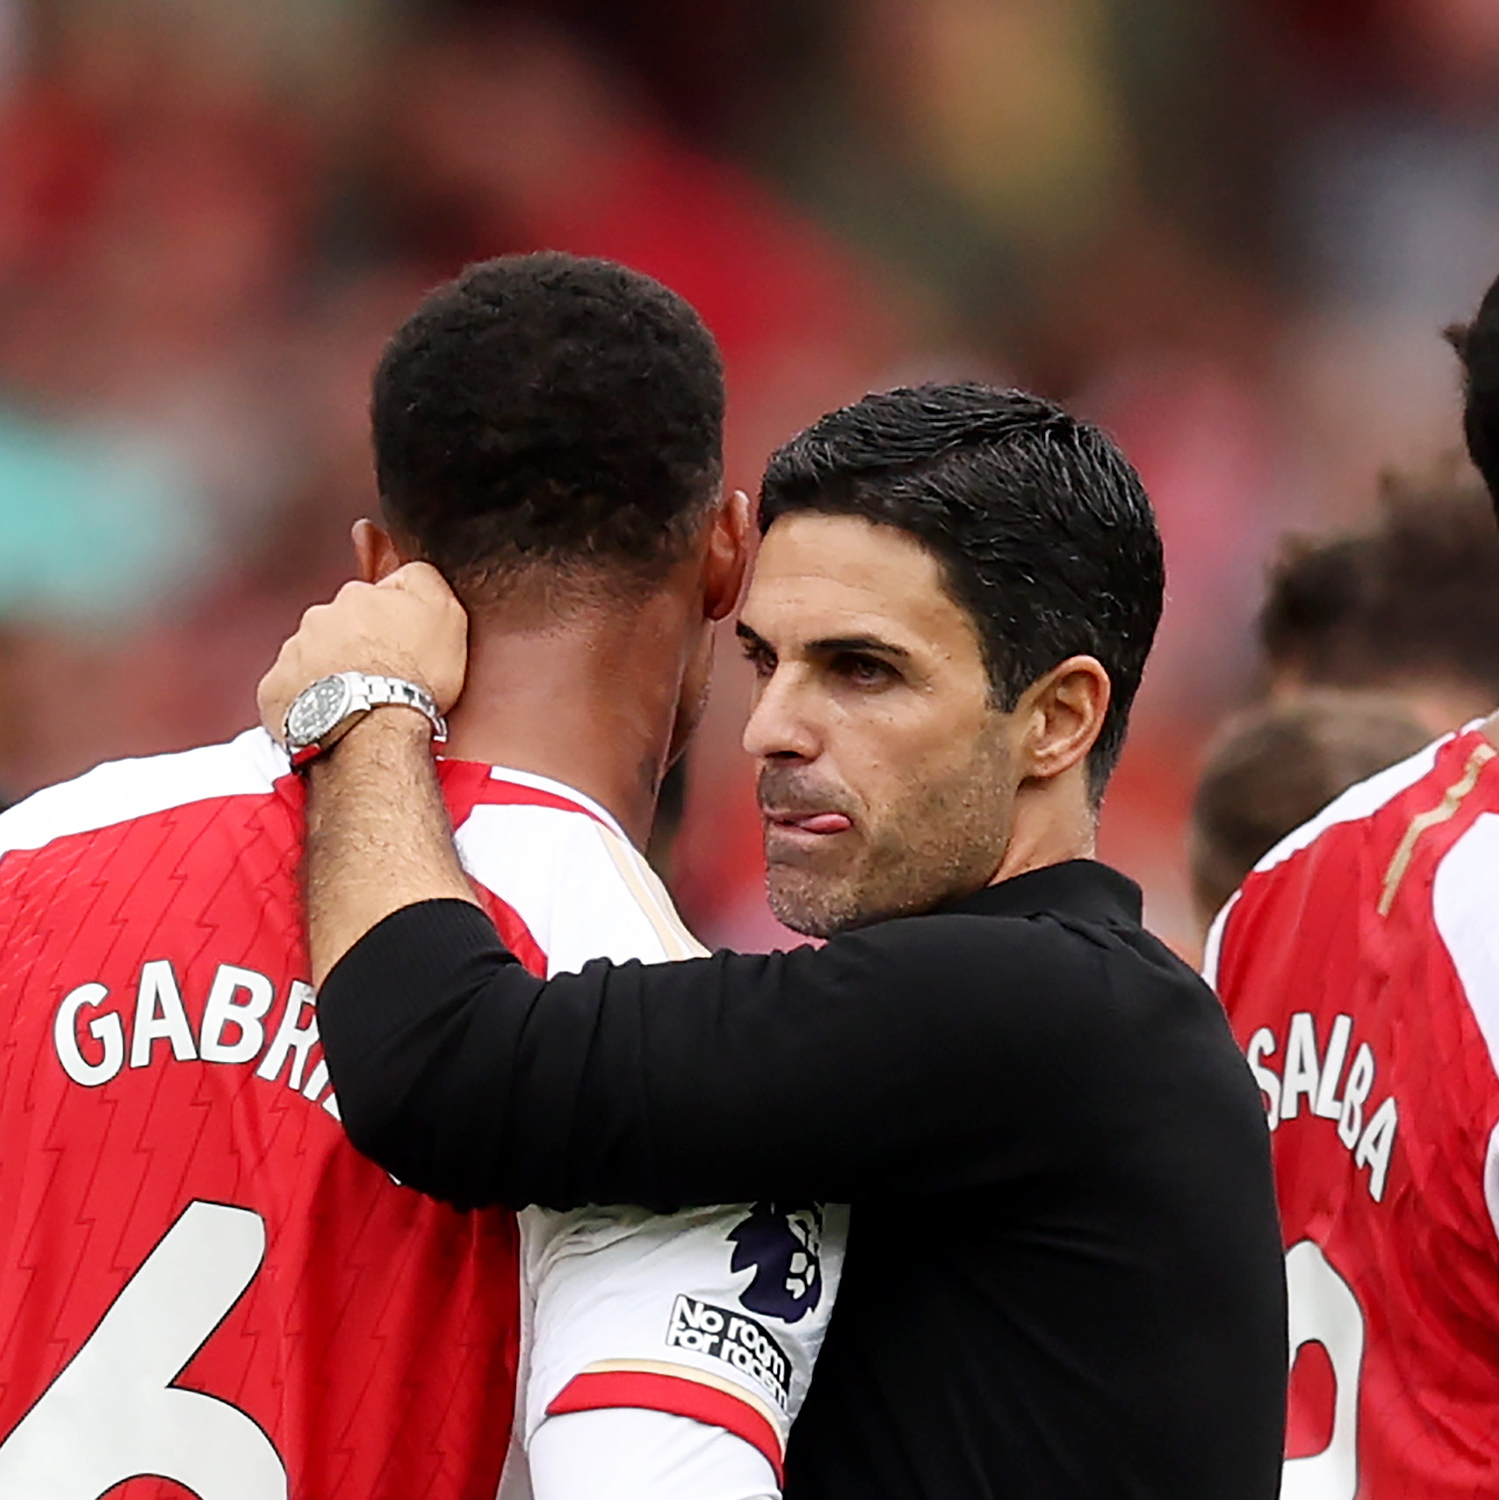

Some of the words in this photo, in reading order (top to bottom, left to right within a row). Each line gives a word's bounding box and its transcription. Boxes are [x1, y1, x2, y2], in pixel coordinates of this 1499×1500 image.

[53, 959, 343, 1123] GABR
[666, 1320, 720, 1354] for
[672, 1295, 725, 1334] No
[727, 1316, 786, 1383] room
